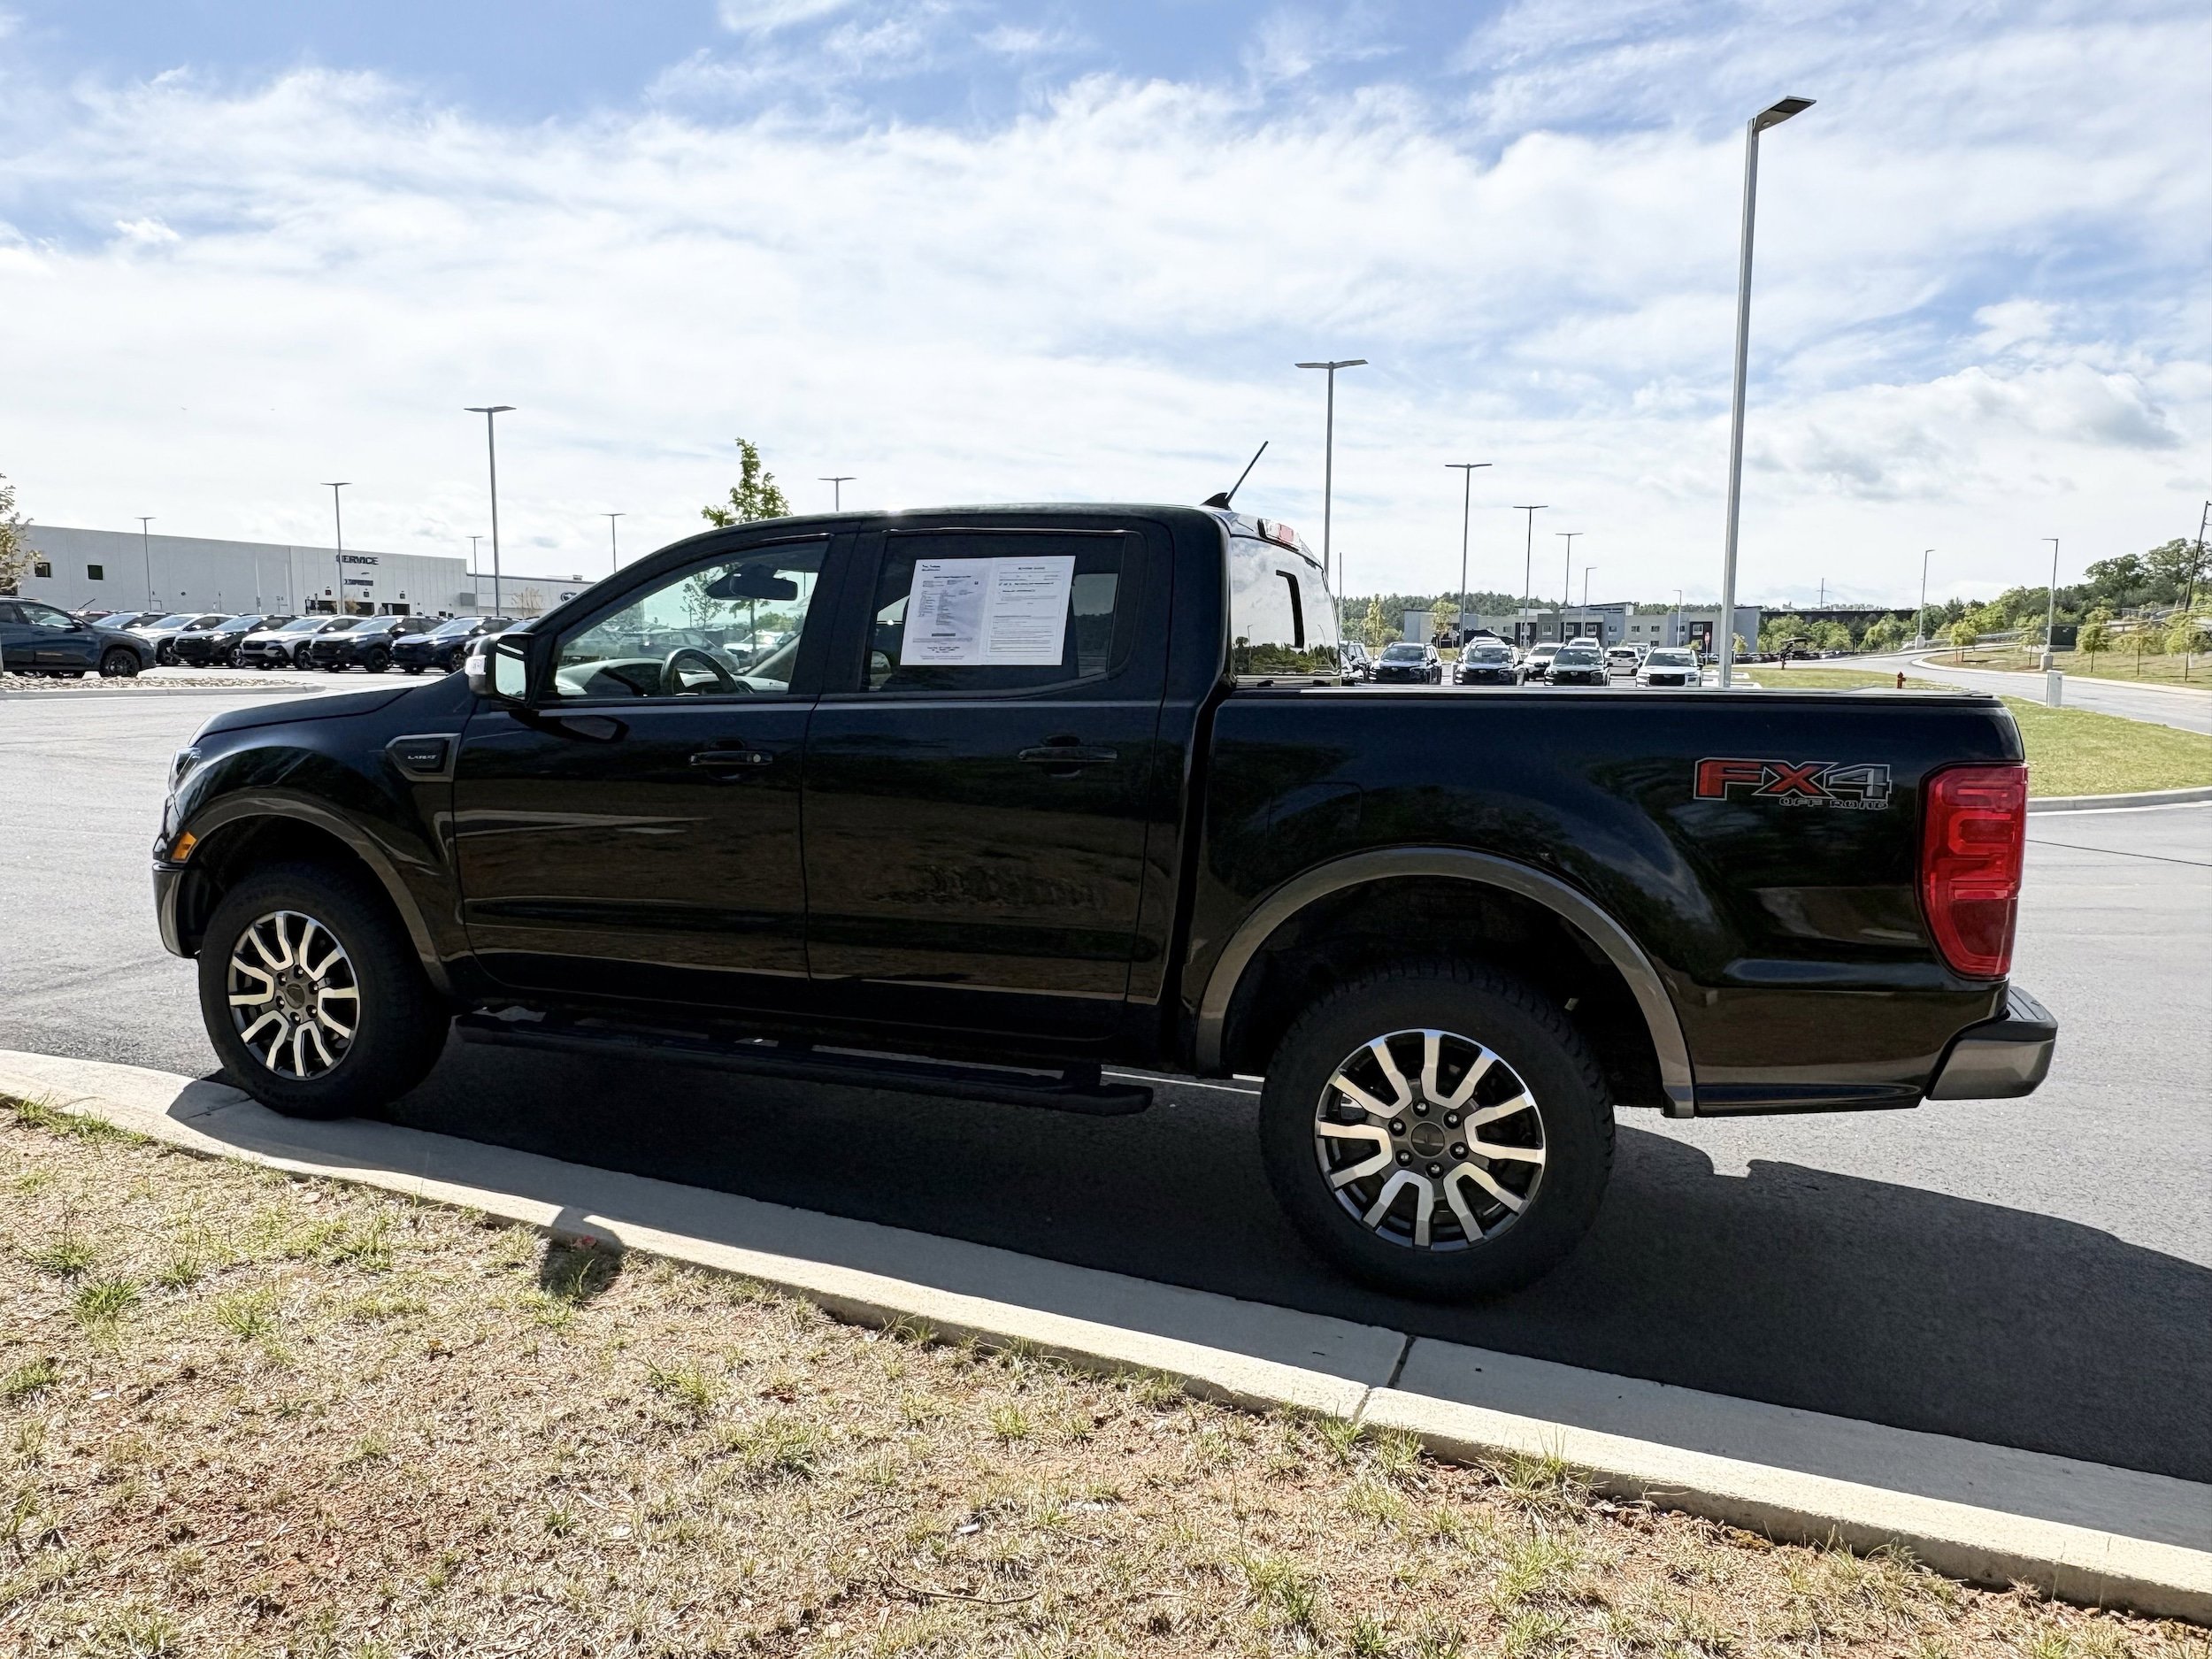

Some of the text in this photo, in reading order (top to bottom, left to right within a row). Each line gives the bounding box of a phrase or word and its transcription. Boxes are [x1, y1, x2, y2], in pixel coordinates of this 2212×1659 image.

[1694, 757, 1892, 801] FX4
[1778, 797, 1889, 810] OFF ROAD
